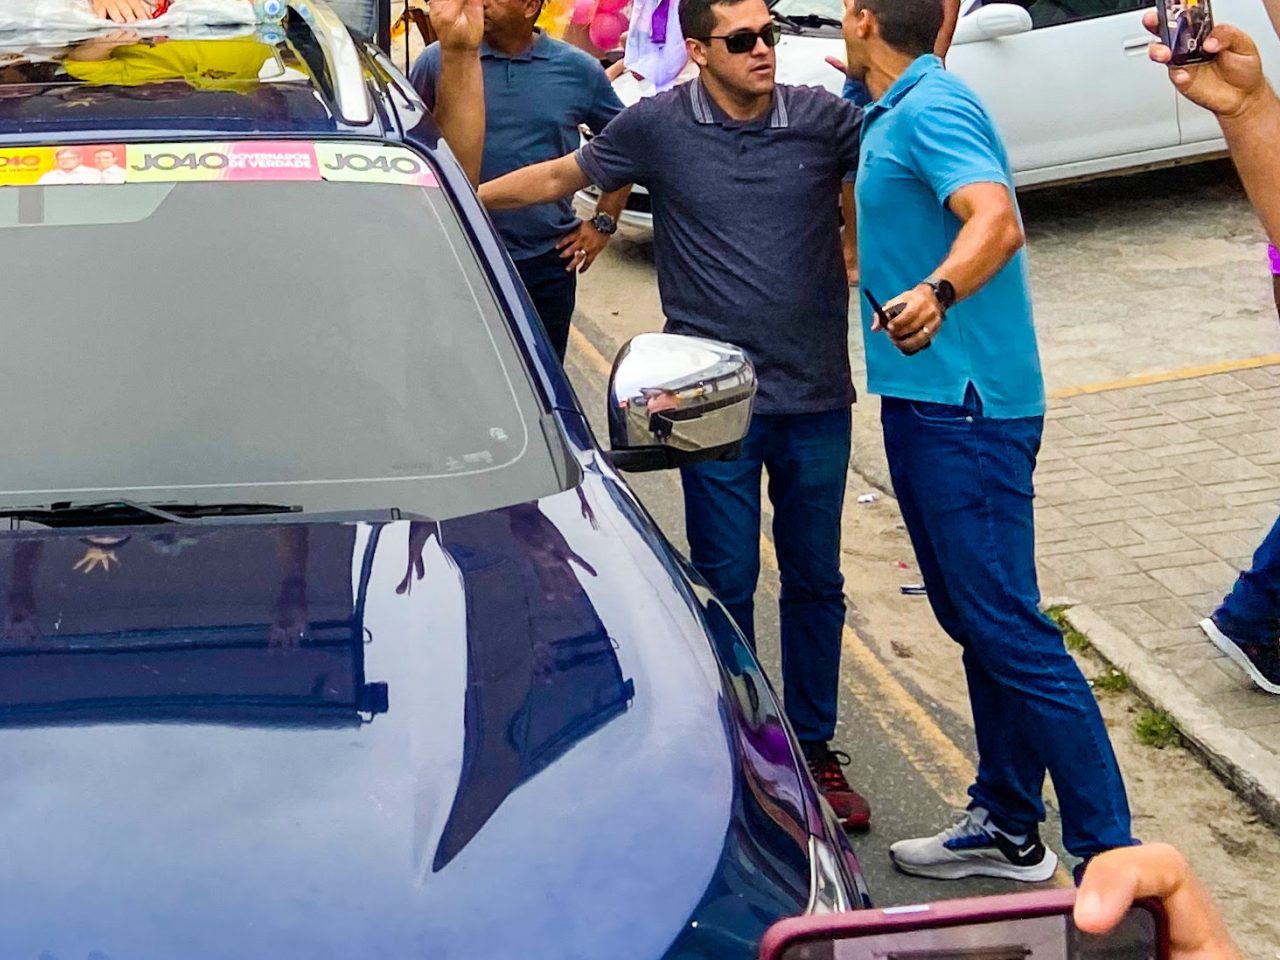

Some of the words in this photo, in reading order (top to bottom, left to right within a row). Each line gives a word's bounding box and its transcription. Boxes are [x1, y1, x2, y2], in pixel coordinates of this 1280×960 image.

[131, 152, 230, 171] JO40
[249, 159, 312, 169] VERDADE
[324, 153, 421, 174] JO40
